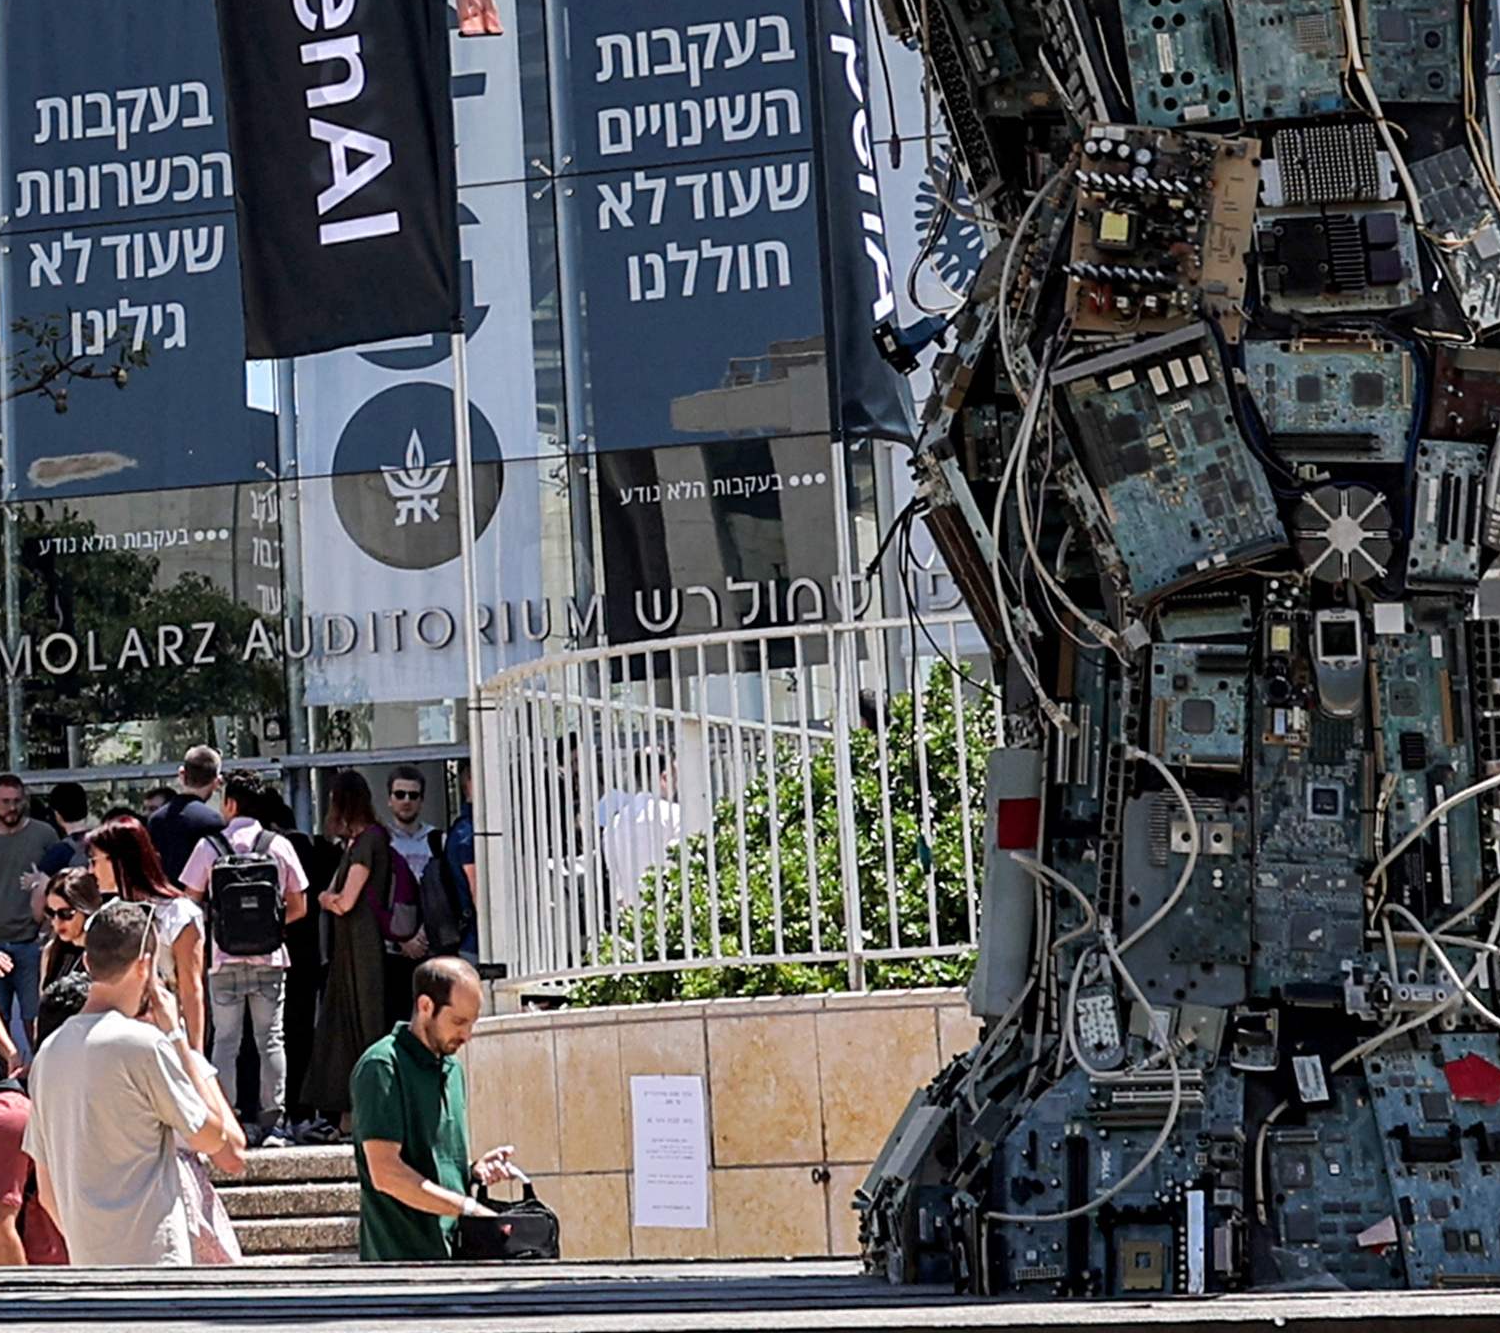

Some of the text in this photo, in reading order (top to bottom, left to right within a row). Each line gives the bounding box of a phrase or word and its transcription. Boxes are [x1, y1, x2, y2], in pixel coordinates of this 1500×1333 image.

[595, 15, 796, 88] בעקבות
[34, 81, 214, 151] בעקבות
[597, 90, 801, 155] השינויים
[15, 146, 232, 218] הכשרונות
[597, 161, 810, 230] שעוד לא
[29, 223, 225, 288] שעוד לא
[627, 240, 791, 302] חוללנו
[71, 299, 187, 357] גילינו
[619, 472, 783, 506] בעקבות הלא נודע
[39, 525, 189, 556] בעקבות הלא נודע
[245, 593, 606, 659] AUDITORIUM
